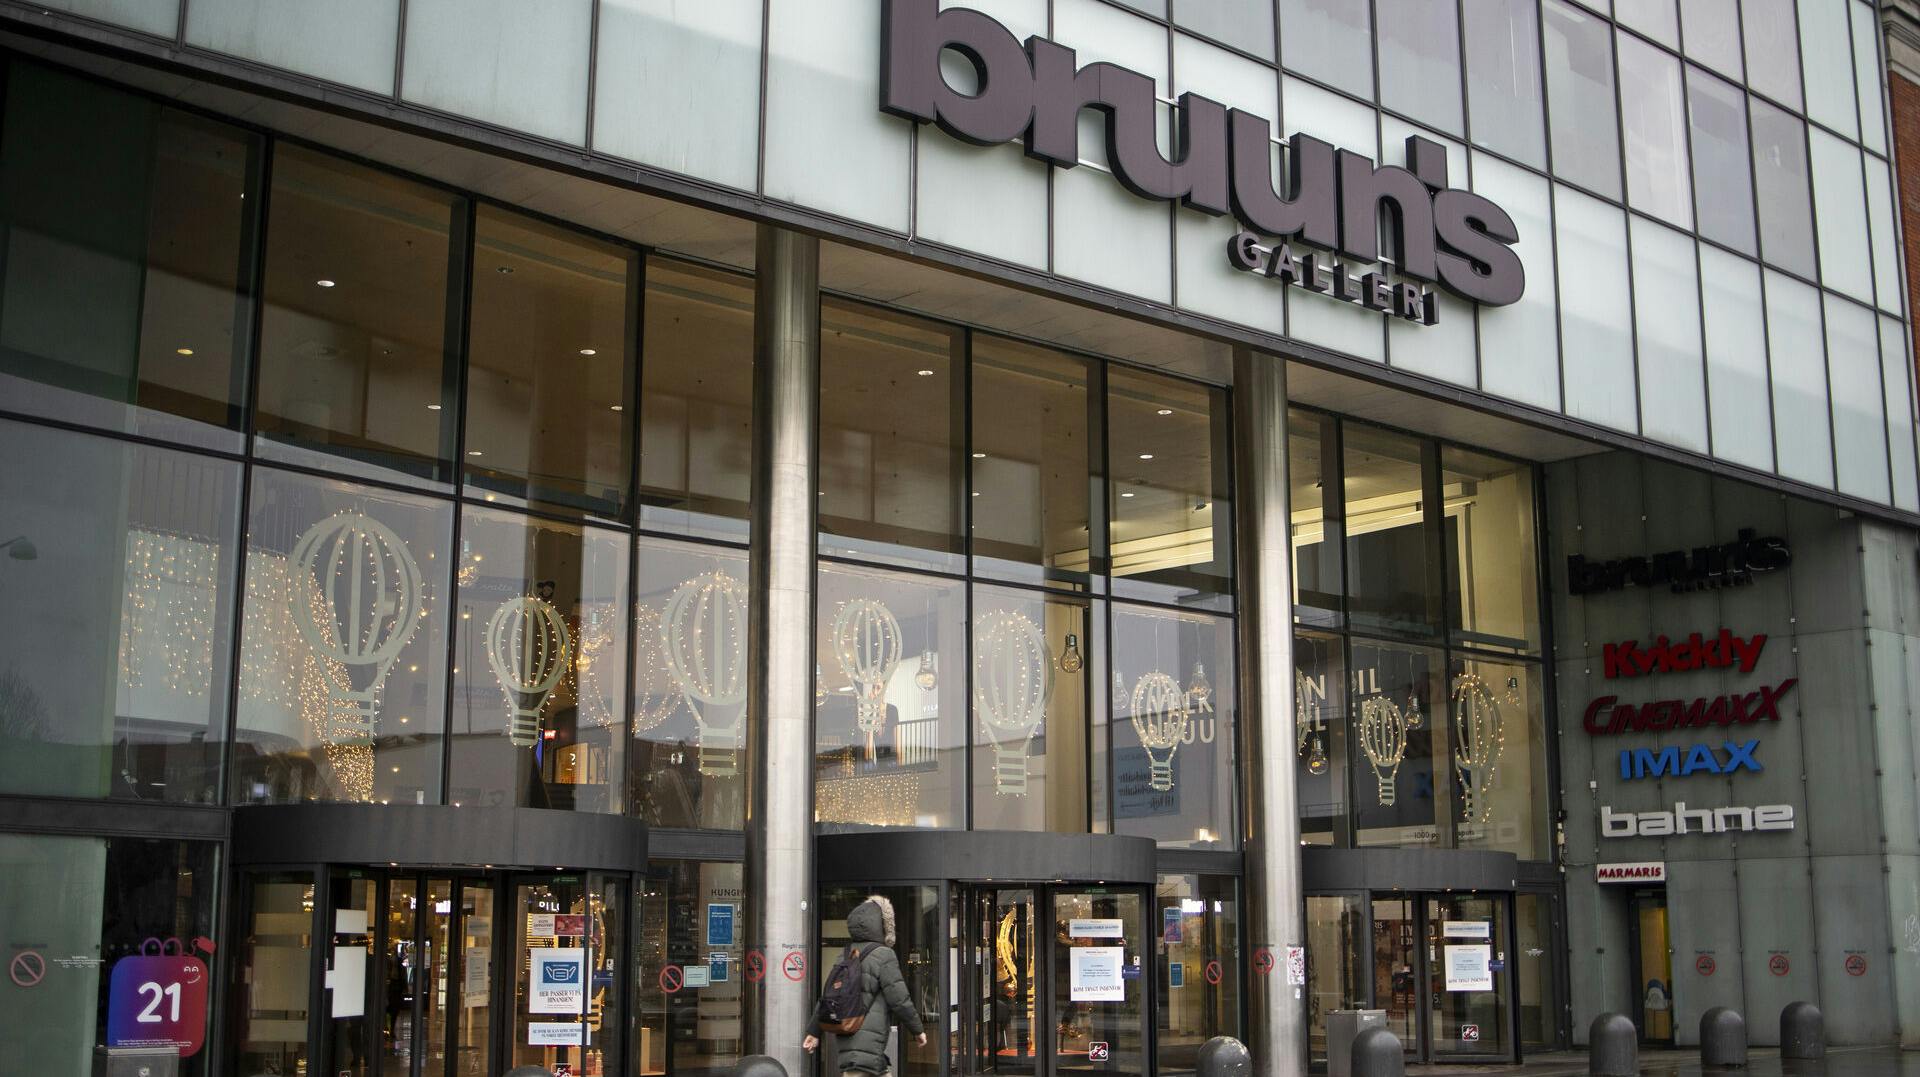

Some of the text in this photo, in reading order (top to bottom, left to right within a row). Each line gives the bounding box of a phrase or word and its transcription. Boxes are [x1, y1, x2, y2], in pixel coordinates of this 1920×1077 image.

[880, 0, 1525, 307] bruun's
[1227, 230, 1440, 326] GALLERI
[1603, 628, 1768, 679] Kvickly
[1620, 740, 1764, 780] IMAX
[1601, 801, 1794, 838] bahne
[1598, 866, 1662, 880] MARMARIS
[136, 981, 182, 1023] 21
